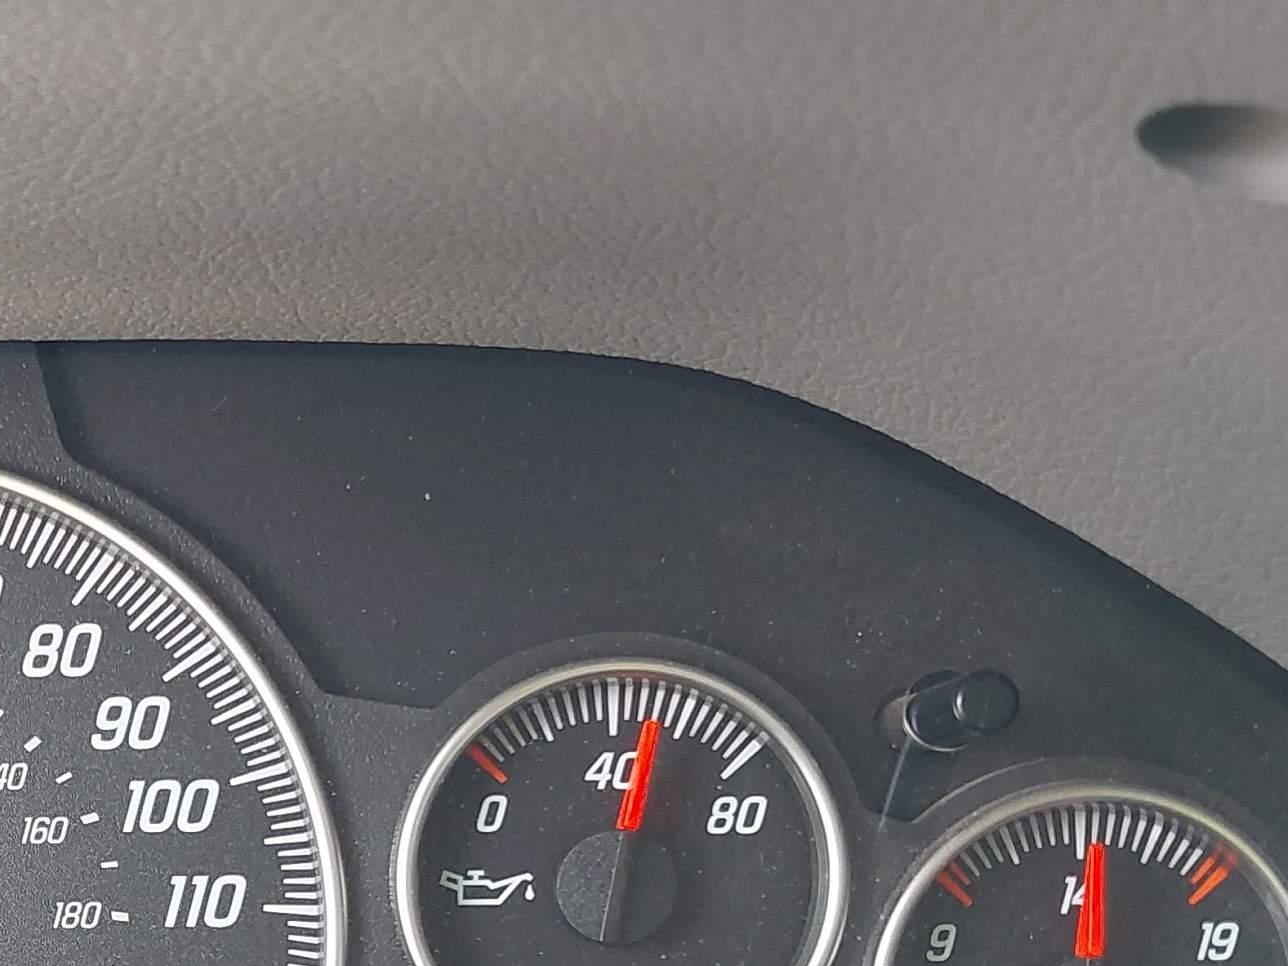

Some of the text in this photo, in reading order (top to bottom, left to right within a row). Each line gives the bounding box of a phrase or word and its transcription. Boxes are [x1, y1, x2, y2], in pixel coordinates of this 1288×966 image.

[22, 624, 102, 678] 80
[91, 696, 171, 751] 90
[584, 752, 641, 790] 40
[122, 780, 220, 833] 100
[476, 794, 508, 833] 0
[706, 796, 767, 835] 80
[21, 816, 69, 845] 160
[53, 902, 102, 930] 180
[164, 874, 247, 928] 110
[926, 924, 957, 961] 9
[1197, 921, 1239, 961] 19
